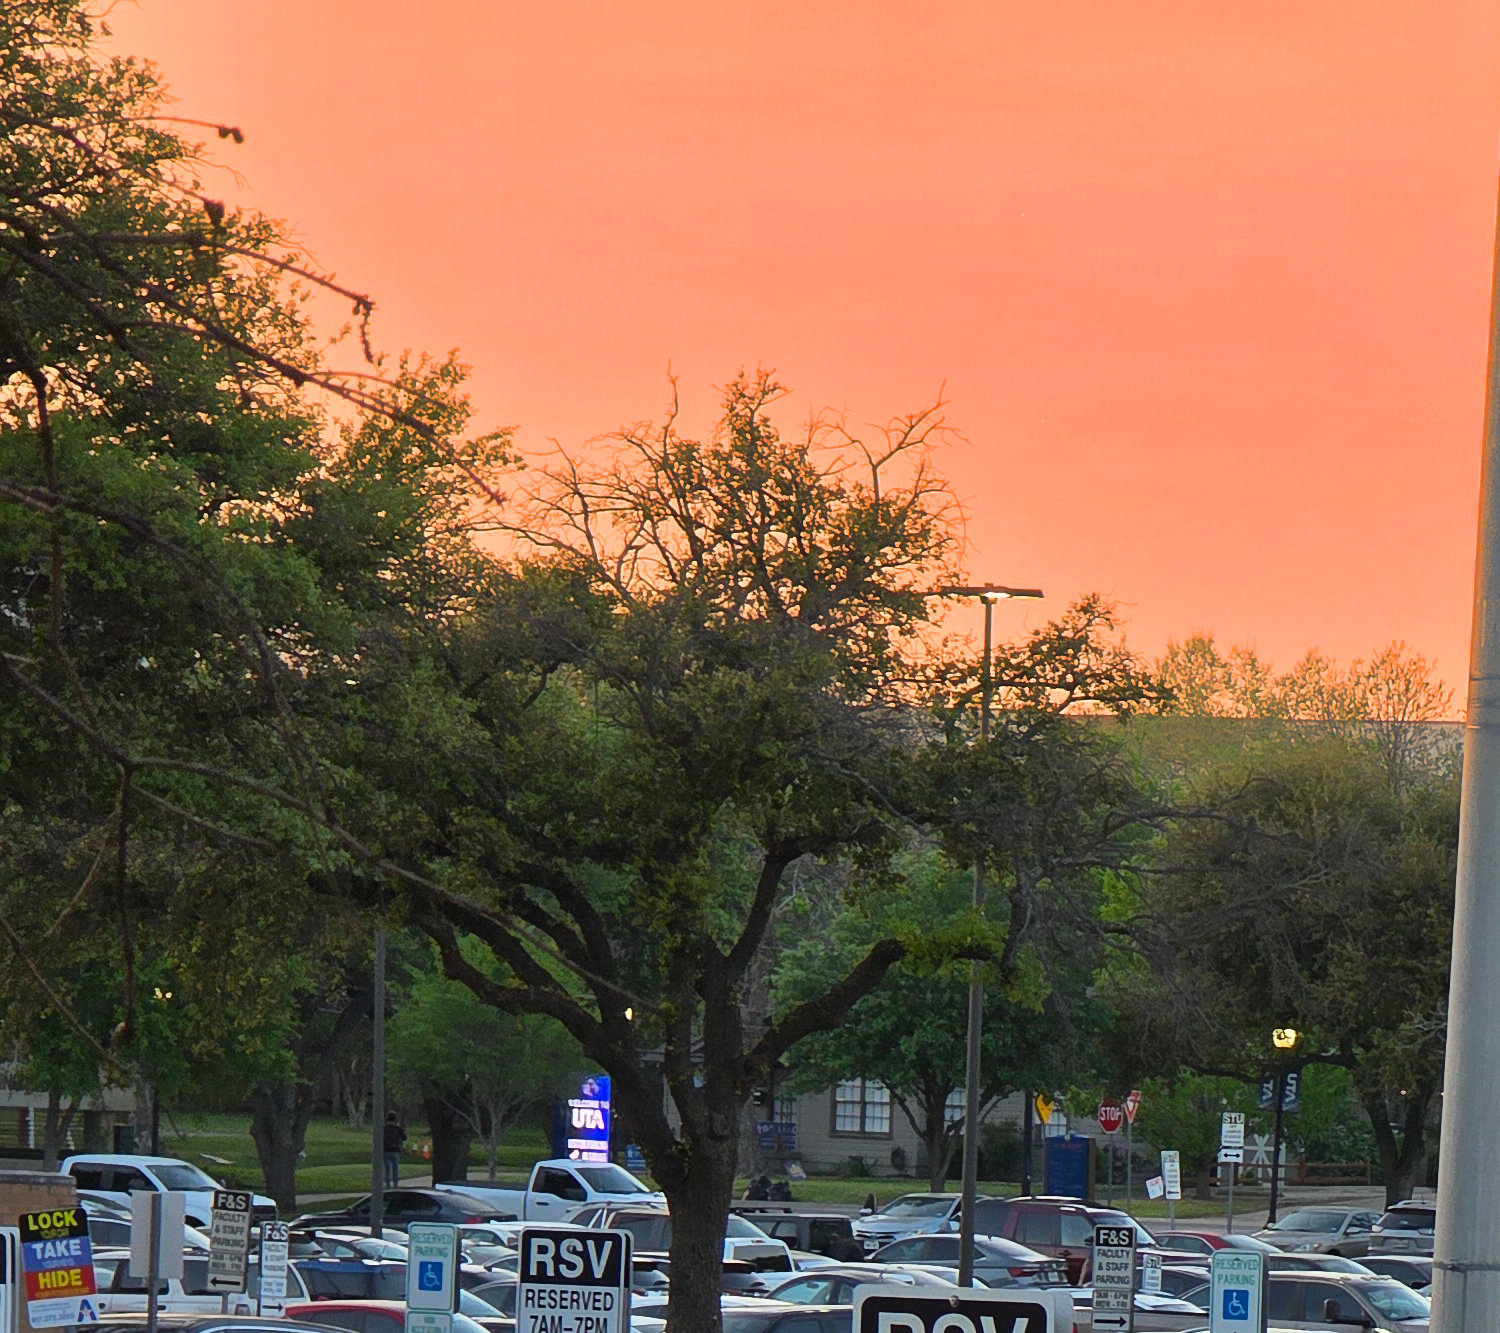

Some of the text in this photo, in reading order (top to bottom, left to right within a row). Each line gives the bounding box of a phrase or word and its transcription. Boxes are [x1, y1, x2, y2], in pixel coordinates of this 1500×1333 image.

[572, 1108, 605, 1130] UTA
[218, 1194, 247, 1210] F&S
[27, 1210, 78, 1231] LOCK
[265, 1223, 287, 1240] F&S
[411, 1232, 454, 1244] RESERVED
[1099, 1229, 1130, 1246] F&S
[31, 1240, 82, 1260] TAKE
[414, 1245, 449, 1258] PARKING
[529, 1237, 613, 1279] RSV
[1097, 1248, 1131, 1259] FACULTY
[1105, 1262, 1130, 1272] STAFF
[1215, 1259, 1259, 1271] RESERVED
[37, 1269, 82, 1289] HIDE
[1096, 1275, 1130, 1285] PARKING
[1217, 1274, 1256, 1286] PARKING
[525, 1289, 614, 1311] RESERVED
